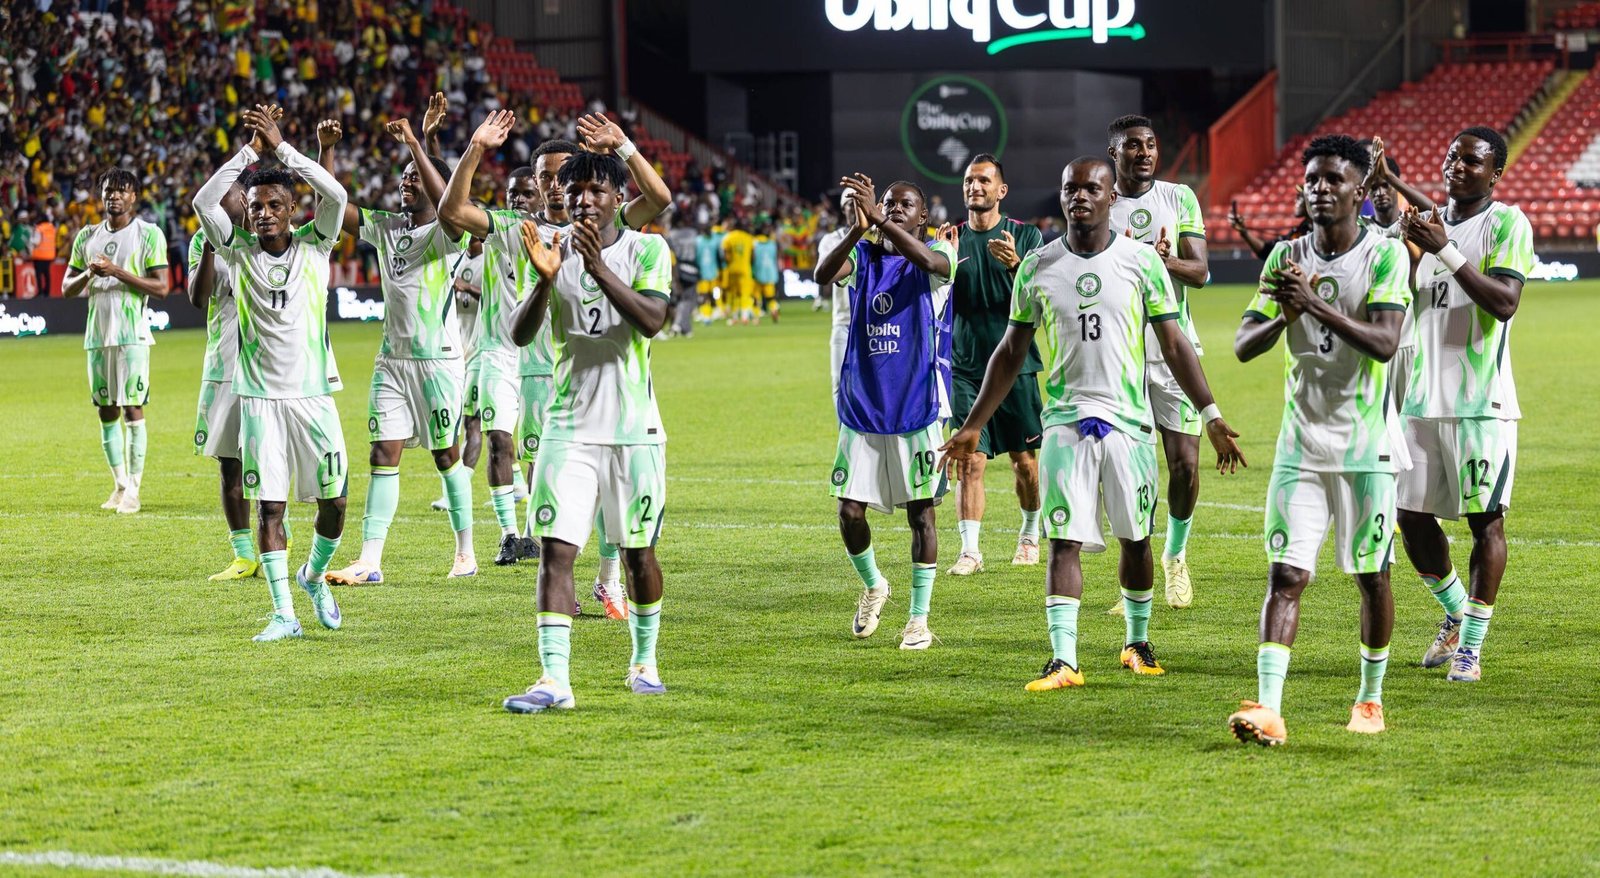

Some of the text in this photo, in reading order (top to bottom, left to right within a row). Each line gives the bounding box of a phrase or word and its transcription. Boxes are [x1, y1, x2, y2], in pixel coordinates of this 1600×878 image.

[999, 0, 1135, 43] Cup
[269, 290, 286, 309] 11
[1431, 281, 1449, 309] 12
[588, 307, 602, 335] 2
[1078, 313, 1102, 342] 13
[868, 338, 898, 354] Cup
[1320, 325, 1333, 354] 3
[136, 375, 144, 392] 6
[471, 385, 479, 402] 8
[432, 408, 450, 430] 18
[324, 451, 341, 477] 11
[914, 450, 936, 476] 19
[1467, 458, 1490, 488] 12
[640, 495, 652, 522] 2
[1137, 484, 1149, 512] 13
[1373, 513, 1385, 543] 3
